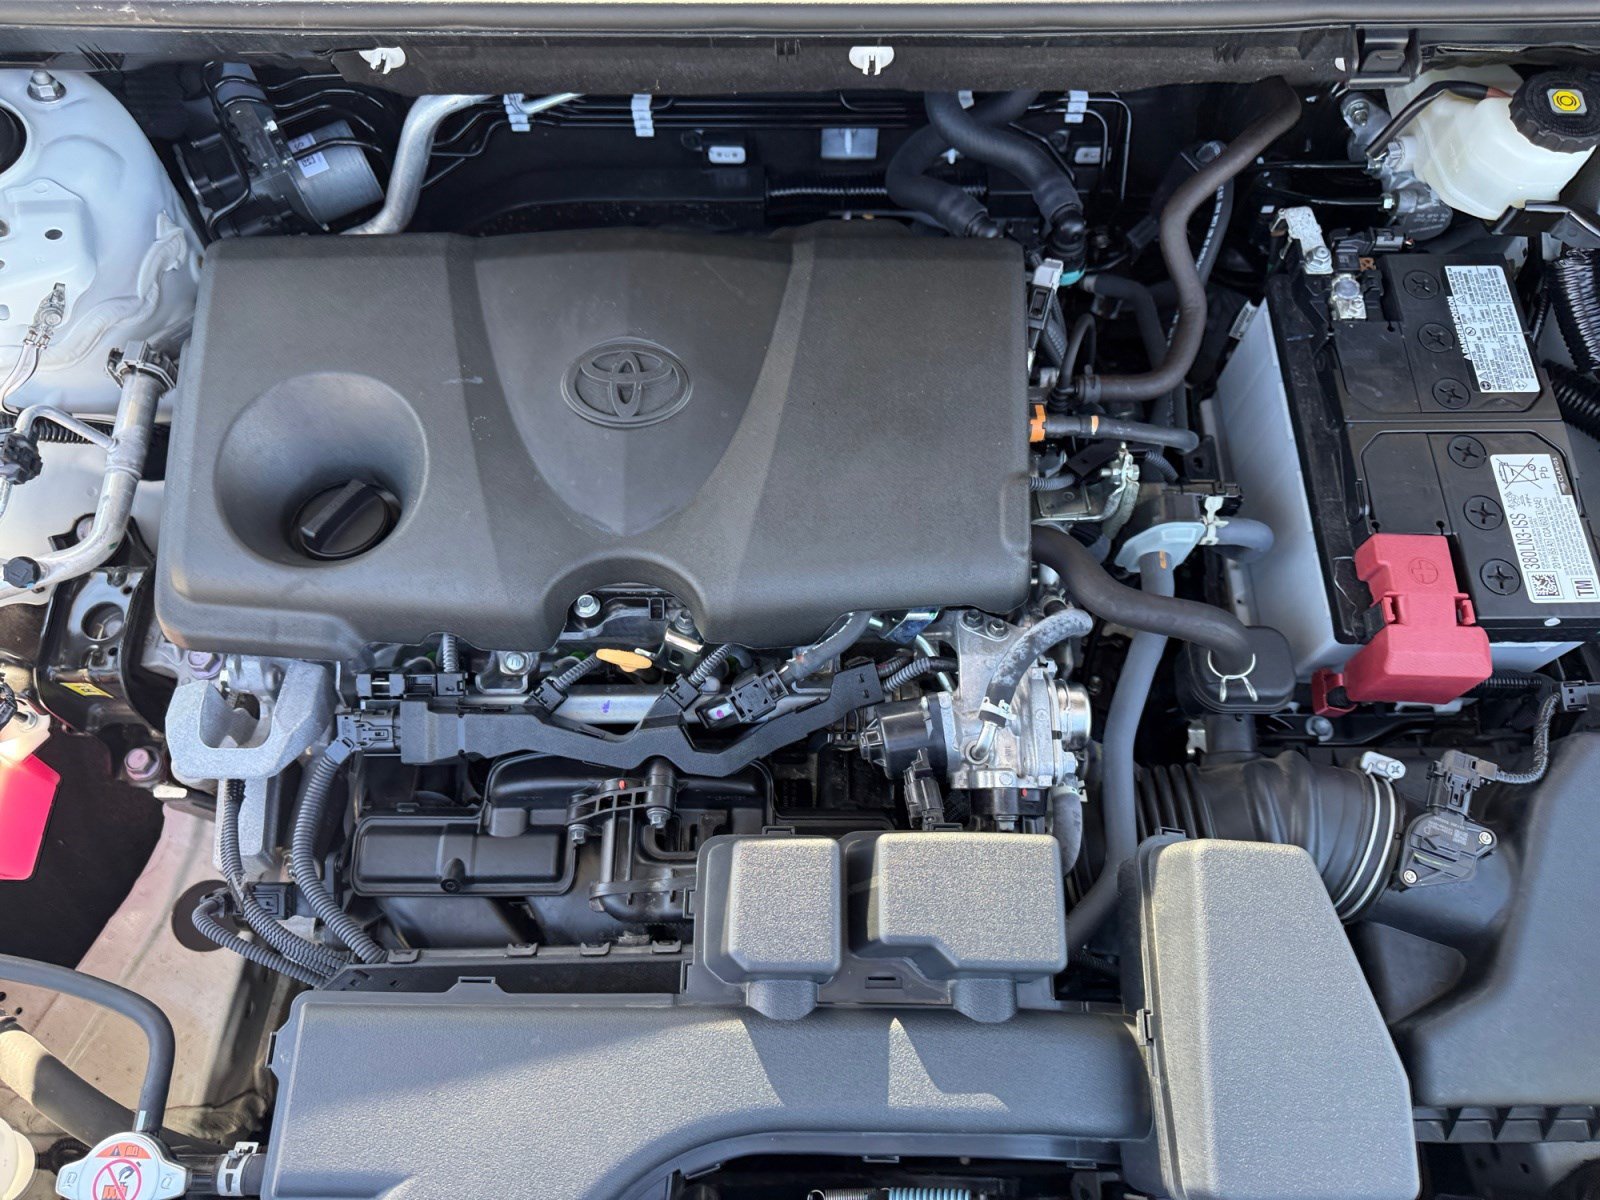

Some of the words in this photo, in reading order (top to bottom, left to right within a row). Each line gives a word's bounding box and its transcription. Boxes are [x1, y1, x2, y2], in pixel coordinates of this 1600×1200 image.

[1446, 296, 1469, 353] DANGER/POISON
[1538, 466, 1550, 479] Pb
[1552, 457, 1564, 481] CLARIOS
[1510, 513, 1540, 569] 380LN3-ISS
[1574, 580, 1595, 596] TM
